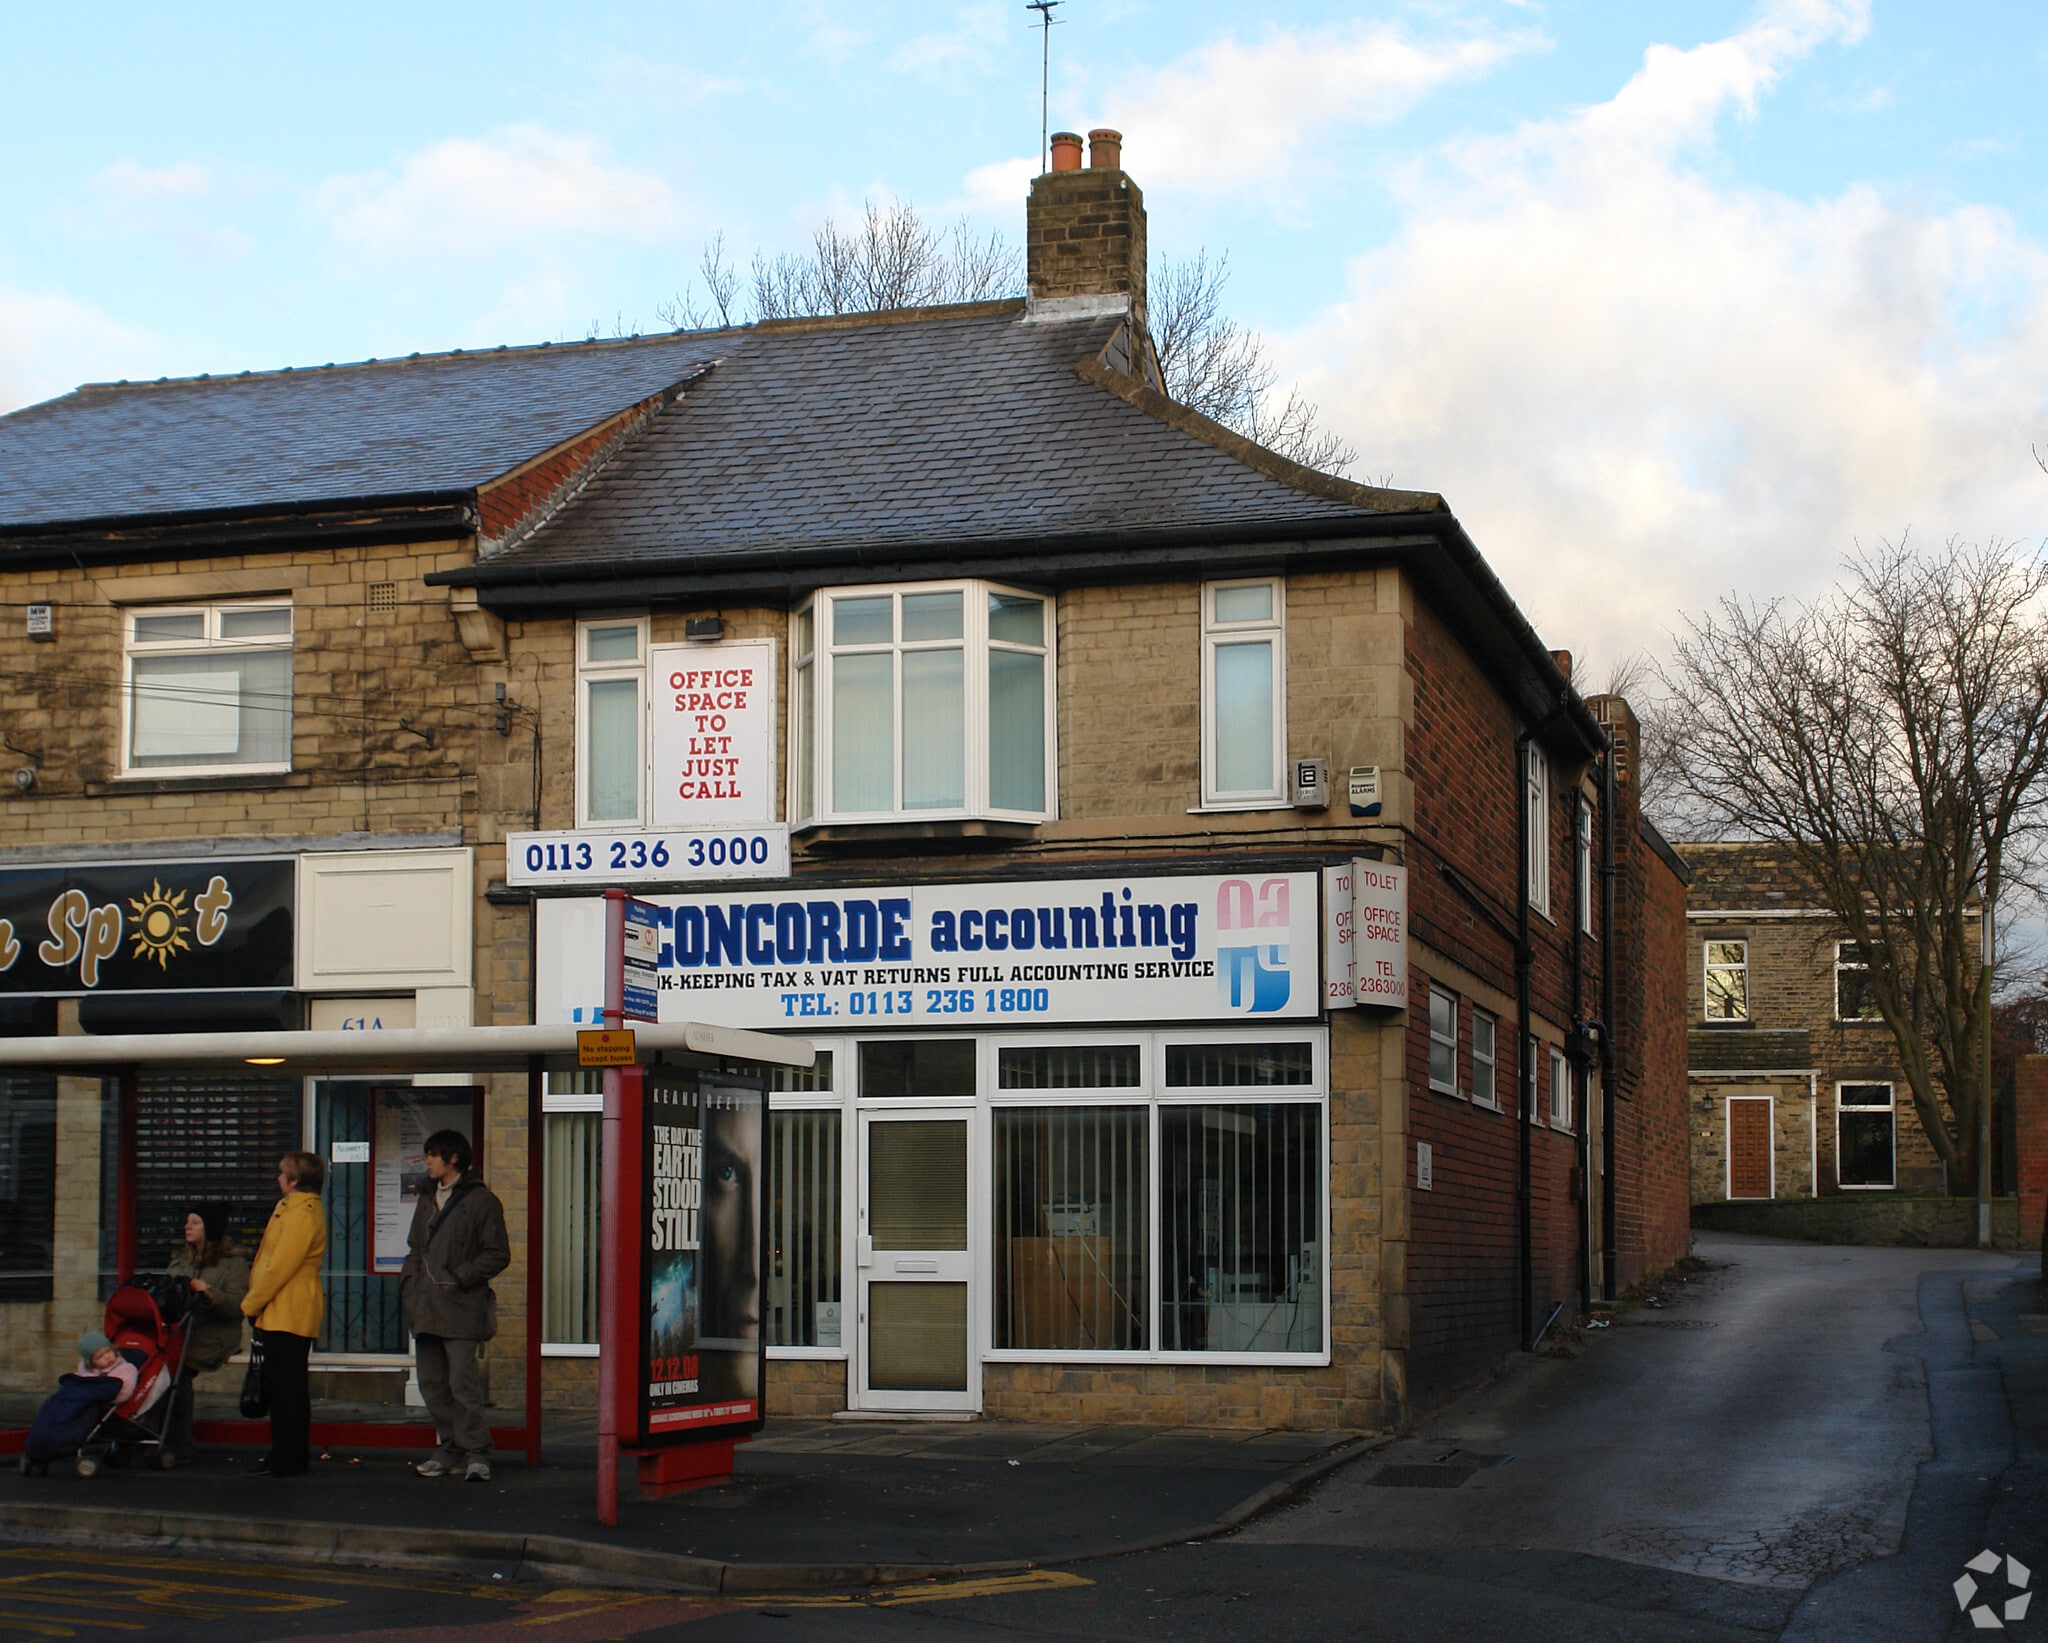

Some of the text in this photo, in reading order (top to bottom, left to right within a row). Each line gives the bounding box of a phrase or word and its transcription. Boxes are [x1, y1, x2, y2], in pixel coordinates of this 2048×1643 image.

[669, 669, 753, 690] OFFICE
[675, 691, 747, 712] SPACE
[695, 714, 727, 733] TO
[689, 736, 732, 755] LET
[682, 758, 739, 777] JUST
[679, 780, 742, 800] CALL
[526, 836, 768, 872] 0113 236 3000
[1336, 876, 1350, 892] TO
[1364, 871, 1398, 891] TO LET
[1364, 906, 1401, 926] OFFICE
[657, 899, 913, 969] CONCORDE
[930, 887, 1199, 961] accounting
[1367, 924, 1400, 943] SPACE
[657, 972, 755, 990] K-KEEPING
[761, 970, 797, 988] TAX
[804, 971, 815, 986] &
[821, 968, 857, 986] VAT
[865, 965, 950, 985] RETURNS
[958, 965, 1004, 983] FULL
[1010, 963, 1128, 982] ACCOUNTING
[1135, 960, 1214, 979] SERVICE
[1376, 961, 1396, 977] TEL
[1330, 981, 1353, 997] 236
[1360, 977, 1405, 997] 2363000
[781, 987, 1049, 1017] TEL: 0113 236 1800
[597, 1045, 630, 1053] stopping
[653, 1088, 698, 1107] KEANU
[653, 1125, 702, 1146] THE DAY THE
[653, 1144, 702, 1179] EARTH
[653, 1177, 701, 1209] STOOD
[651, 1208, 700, 1251] STILL
[650, 1355, 699, 1382] 12.12.08
